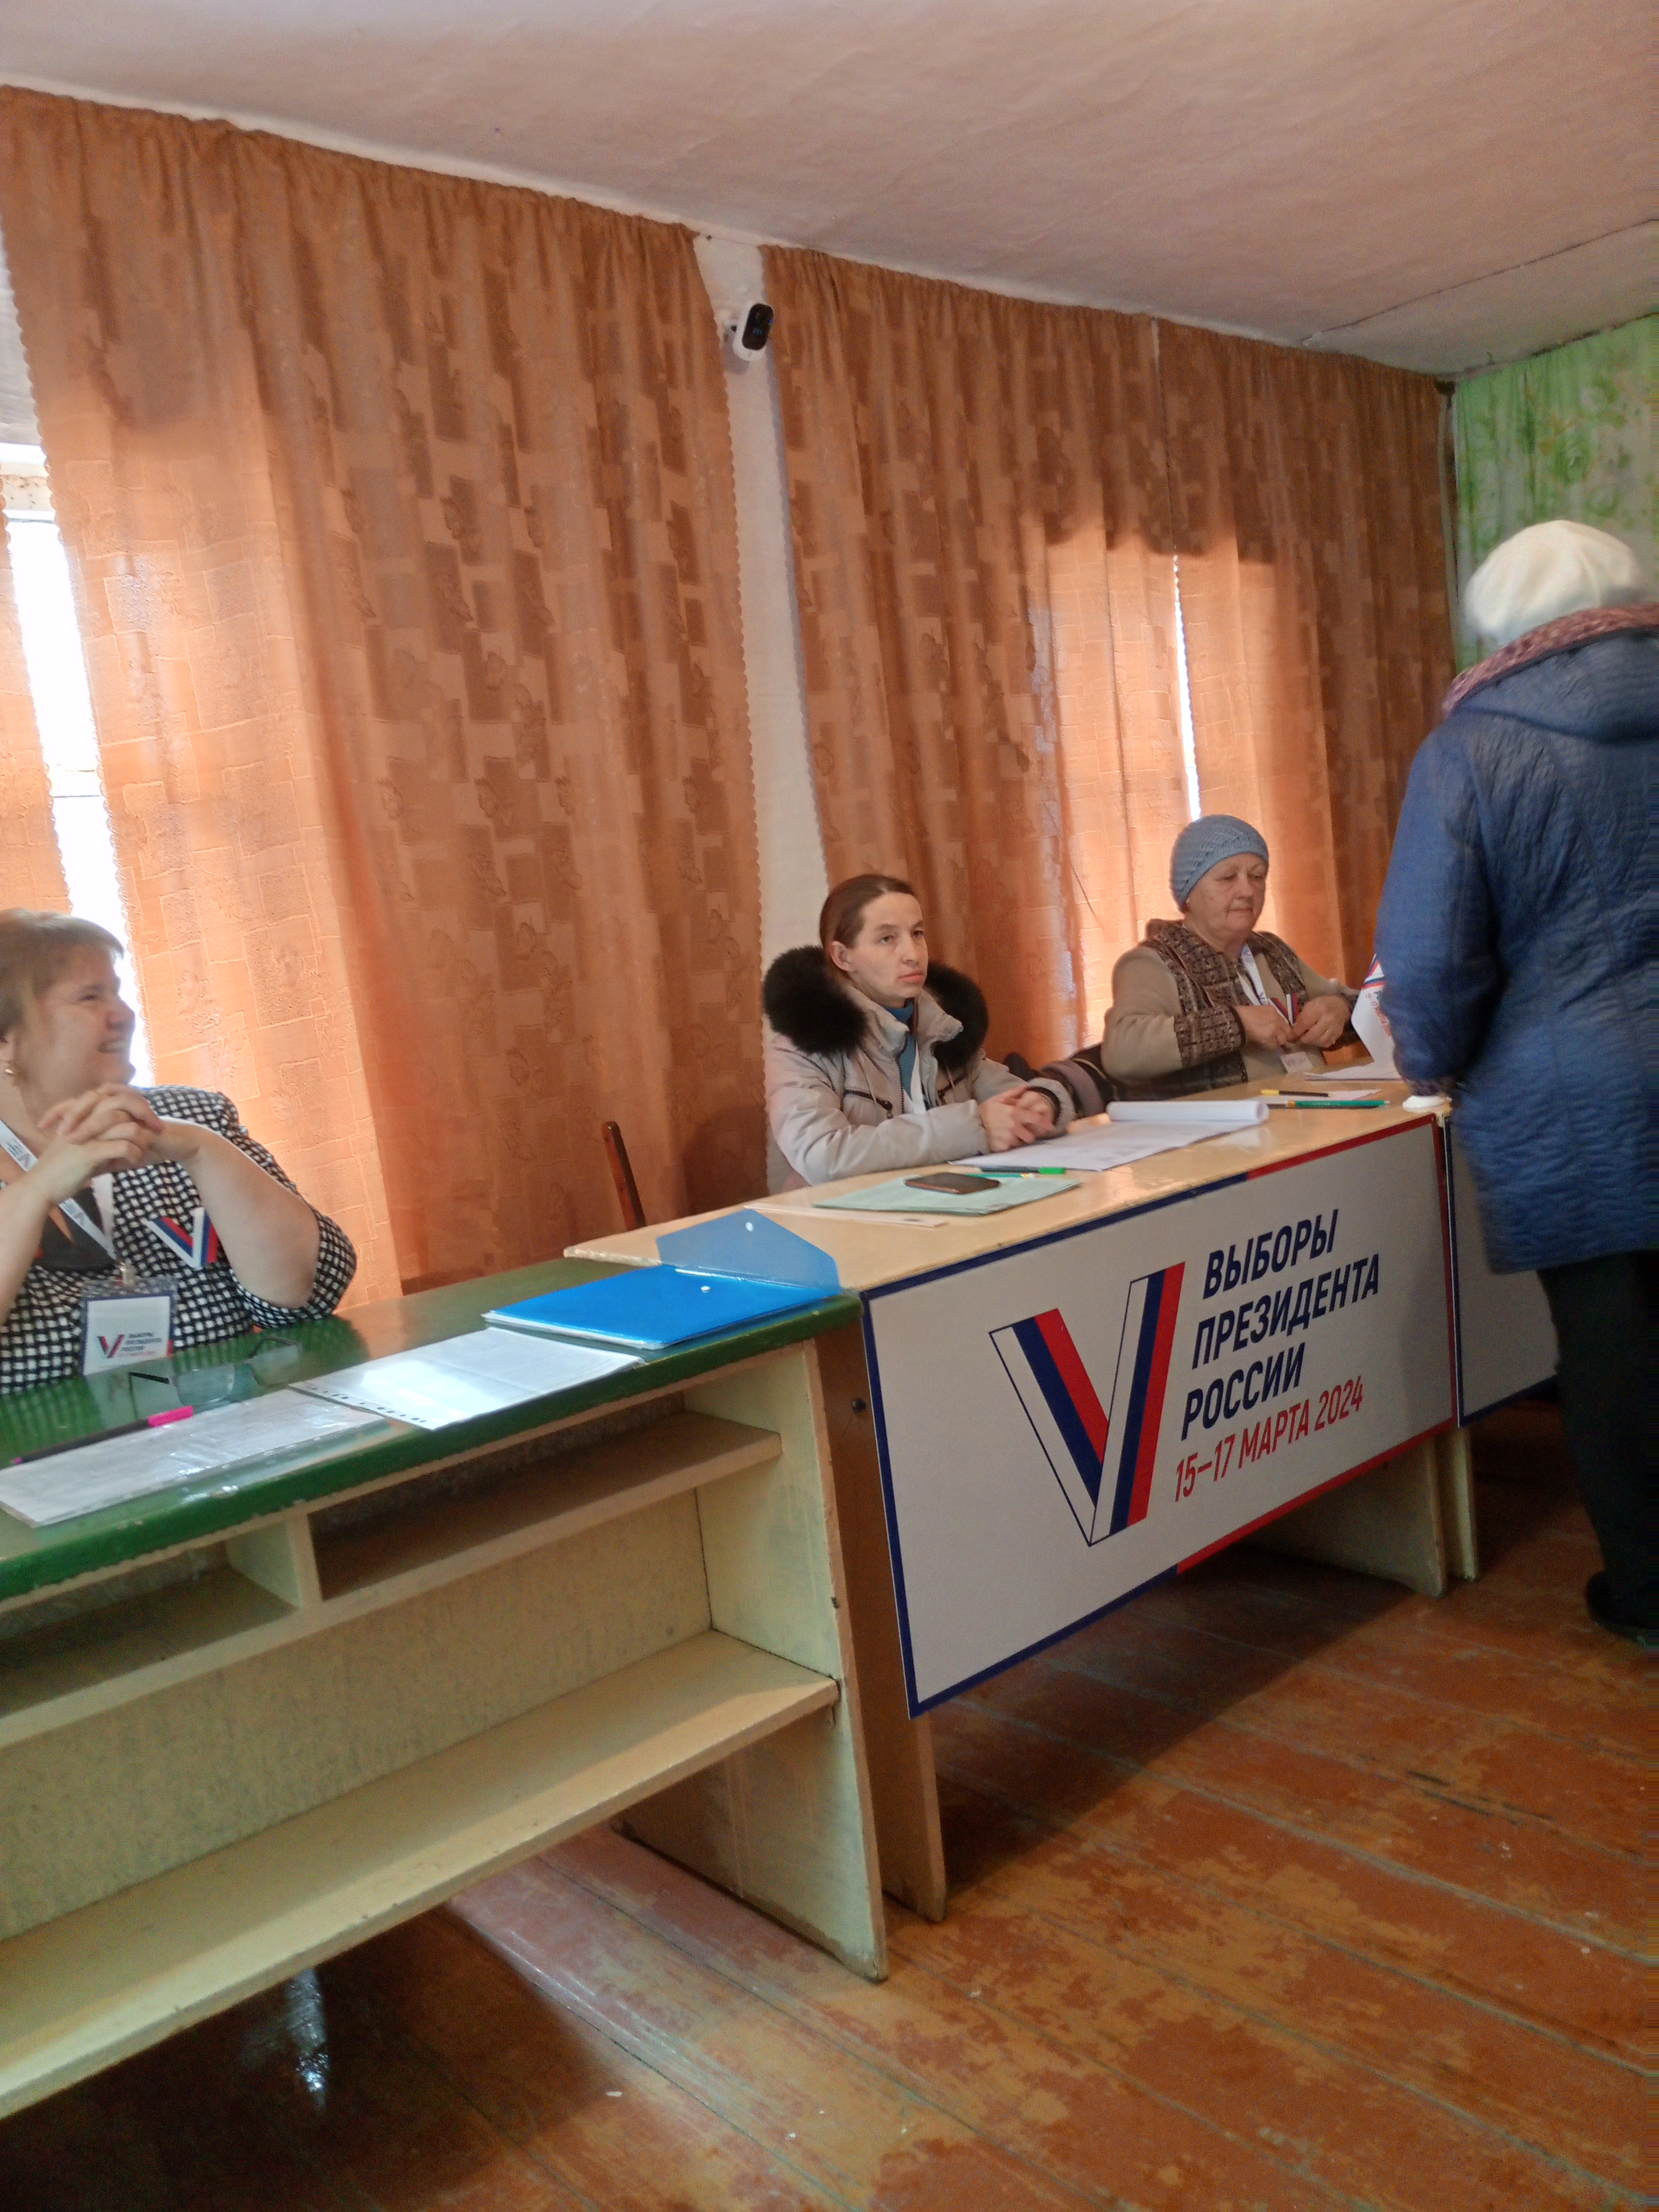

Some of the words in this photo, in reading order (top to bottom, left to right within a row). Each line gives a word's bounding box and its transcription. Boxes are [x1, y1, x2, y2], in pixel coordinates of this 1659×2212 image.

[1202, 1209, 1339, 1300] ВЫБОРЫ
[1191, 1252, 1381, 1370] ПРЕЗИДЕНТА
[1180, 1342, 1305, 1442] РОССИИ
[1238, 1398, 1310, 1470] МАРТА
[1314, 1375, 1363, 1432] 2024
